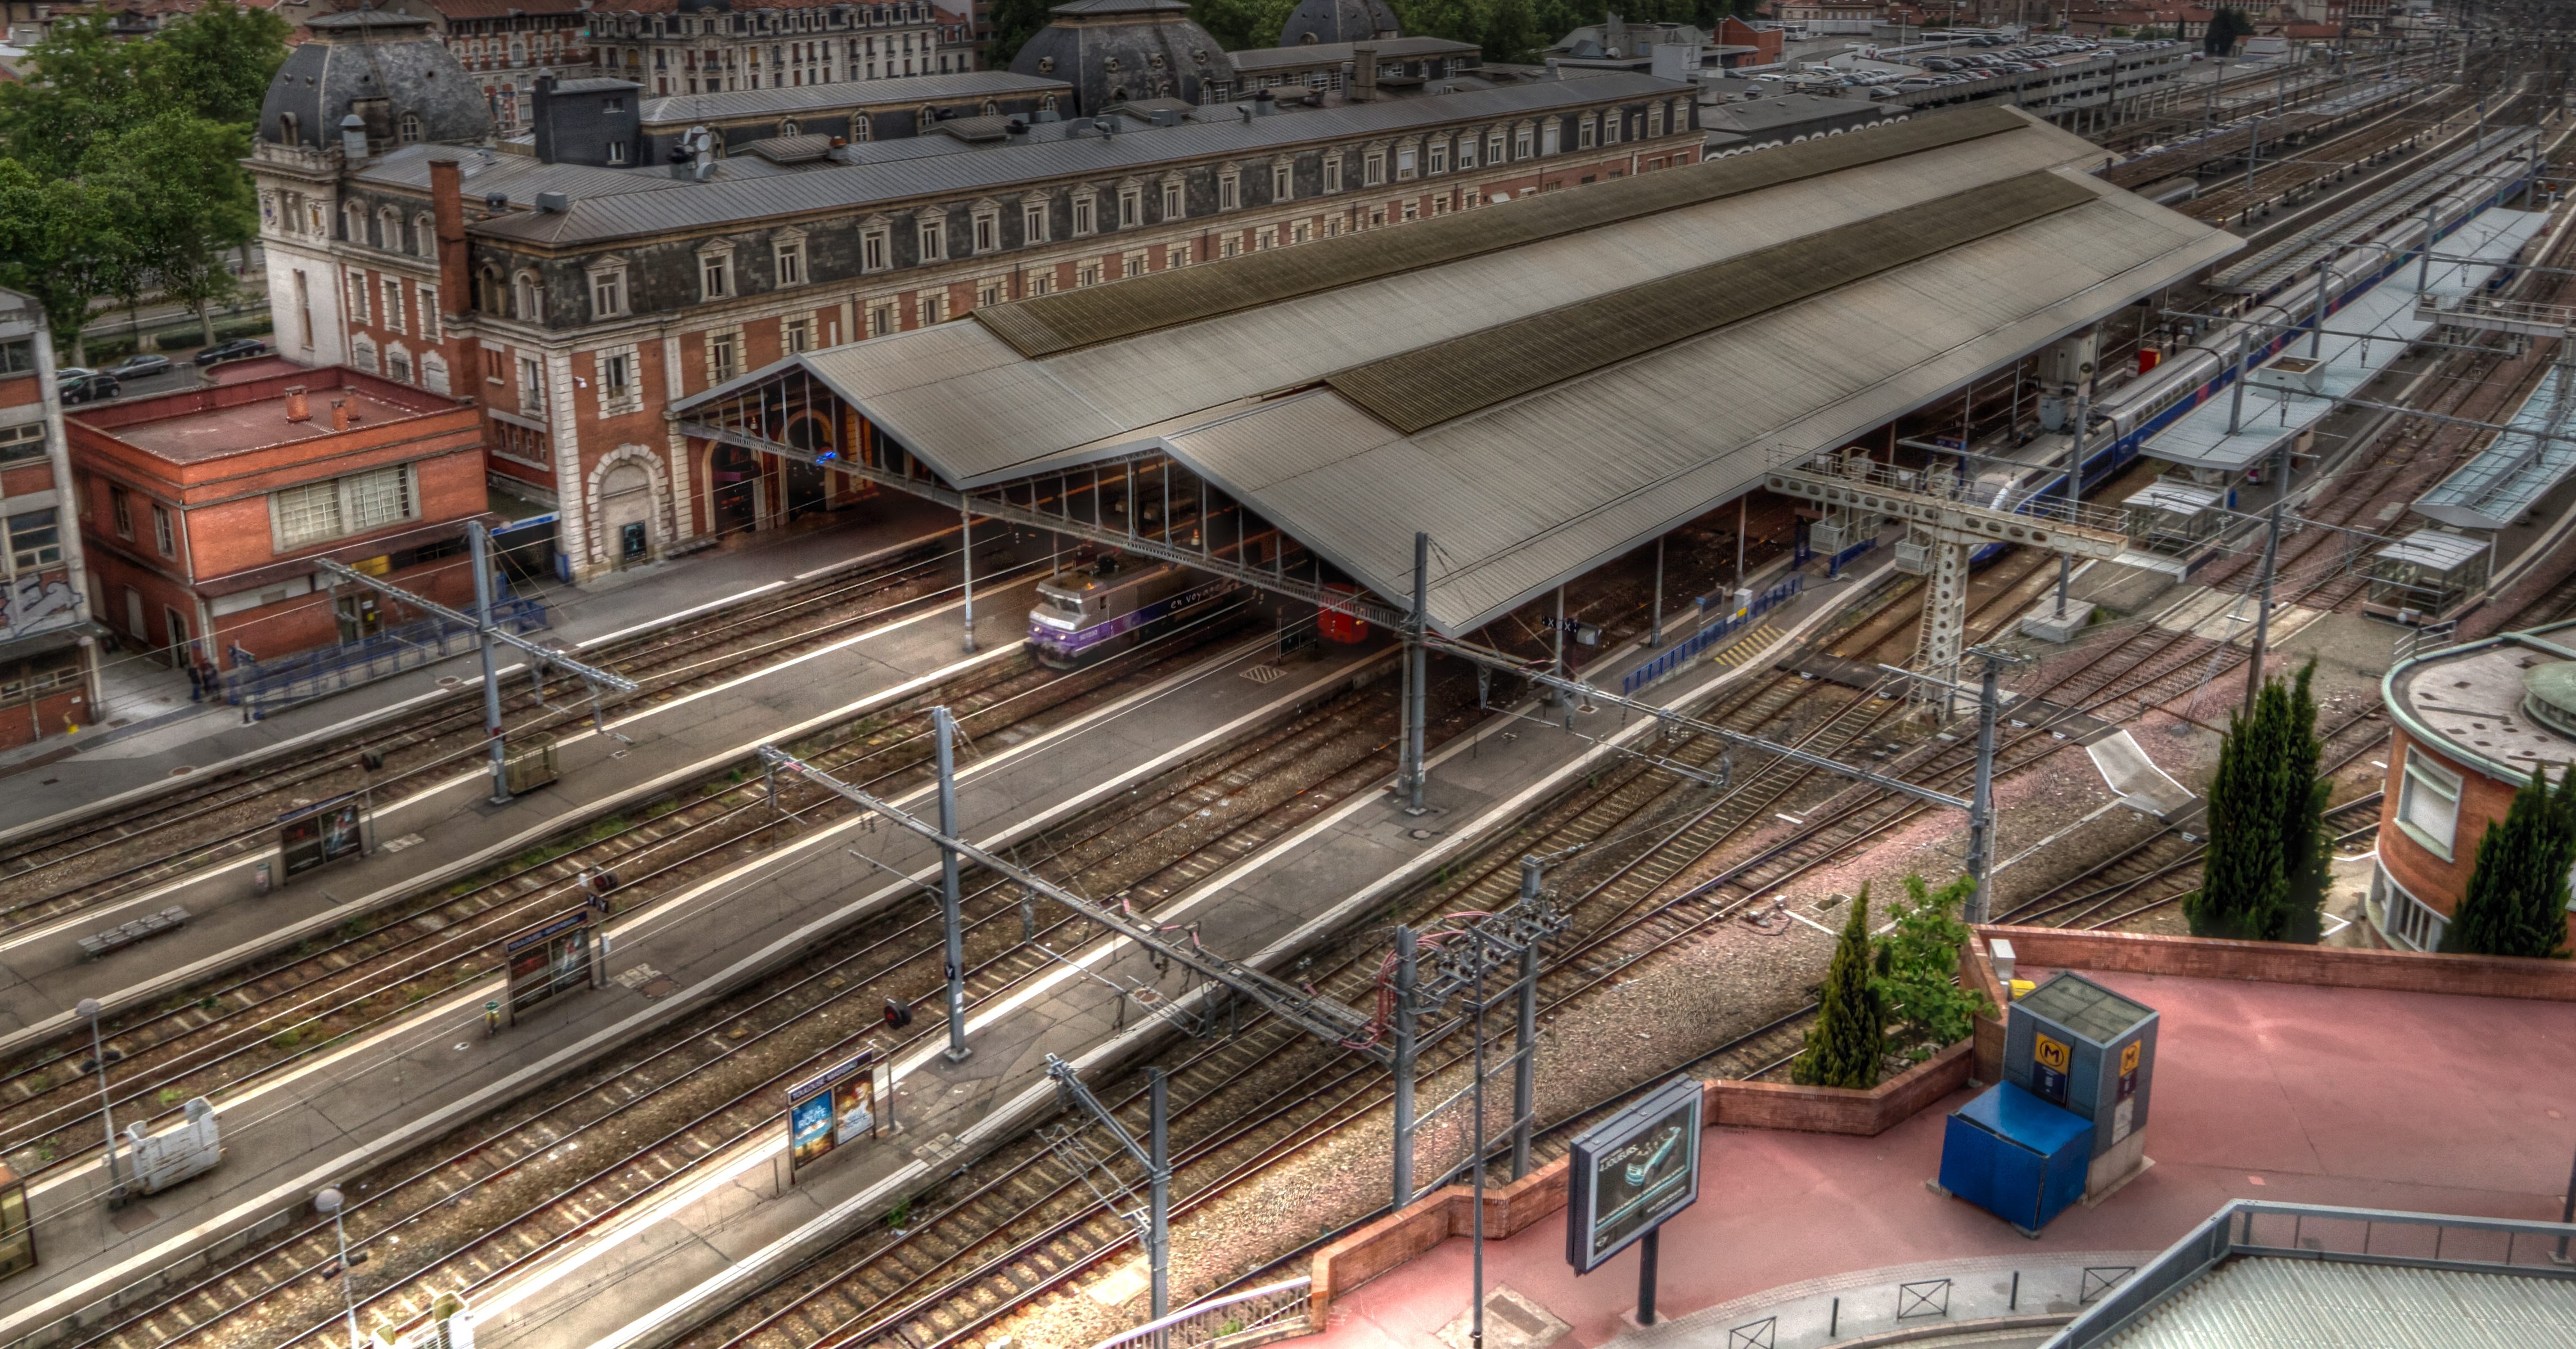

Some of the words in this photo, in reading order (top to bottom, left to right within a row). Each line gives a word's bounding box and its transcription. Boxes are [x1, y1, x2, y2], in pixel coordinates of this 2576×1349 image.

[1170, 599, 1182, 609] en
[946, 965, 953, 977] Y
[2044, 1044, 2059, 1063] M
[798, 1108, 827, 1128] ROUTE
